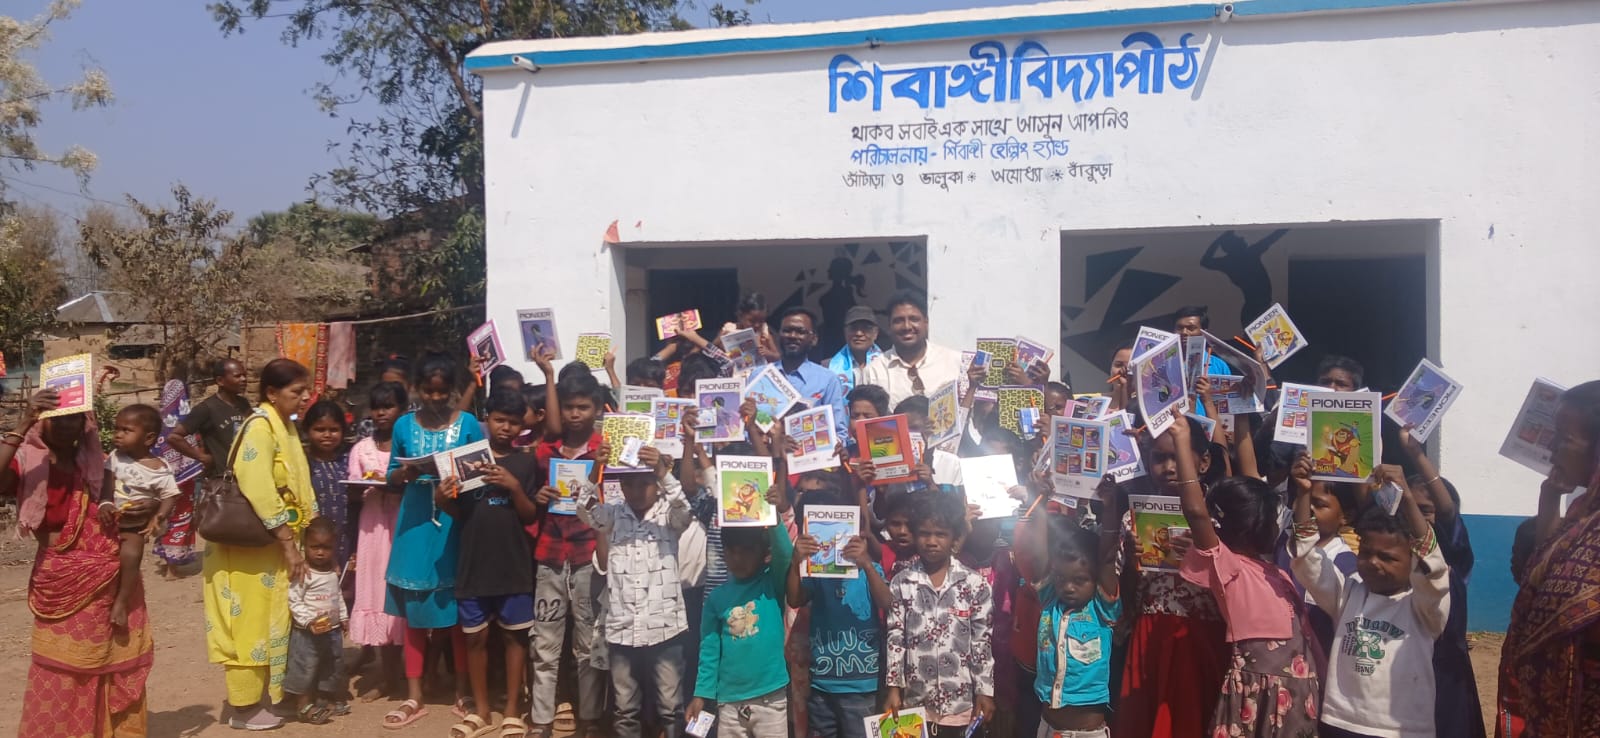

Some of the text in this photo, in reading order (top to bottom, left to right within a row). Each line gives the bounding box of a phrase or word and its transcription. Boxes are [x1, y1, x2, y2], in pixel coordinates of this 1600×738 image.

[970, 117, 1012, 137] সাথে
[519, 311, 551, 320] PIONEER
[1248, 308, 1279, 334] PIONEER
[699, 382, 741, 391] PIONEER
[767, 368, 797, 400] PIONEER
[929, 384, 954, 402] PIONEER
[1311, 398, 1373, 409] PIONEER
[1418, 384, 1457, 435] PIONEER
[1151, 398, 1186, 430] PINEER
[720, 460, 768, 470] PIONEER
[807, 510, 855, 520] PIONEER
[809, 652, 880, 677] OME
